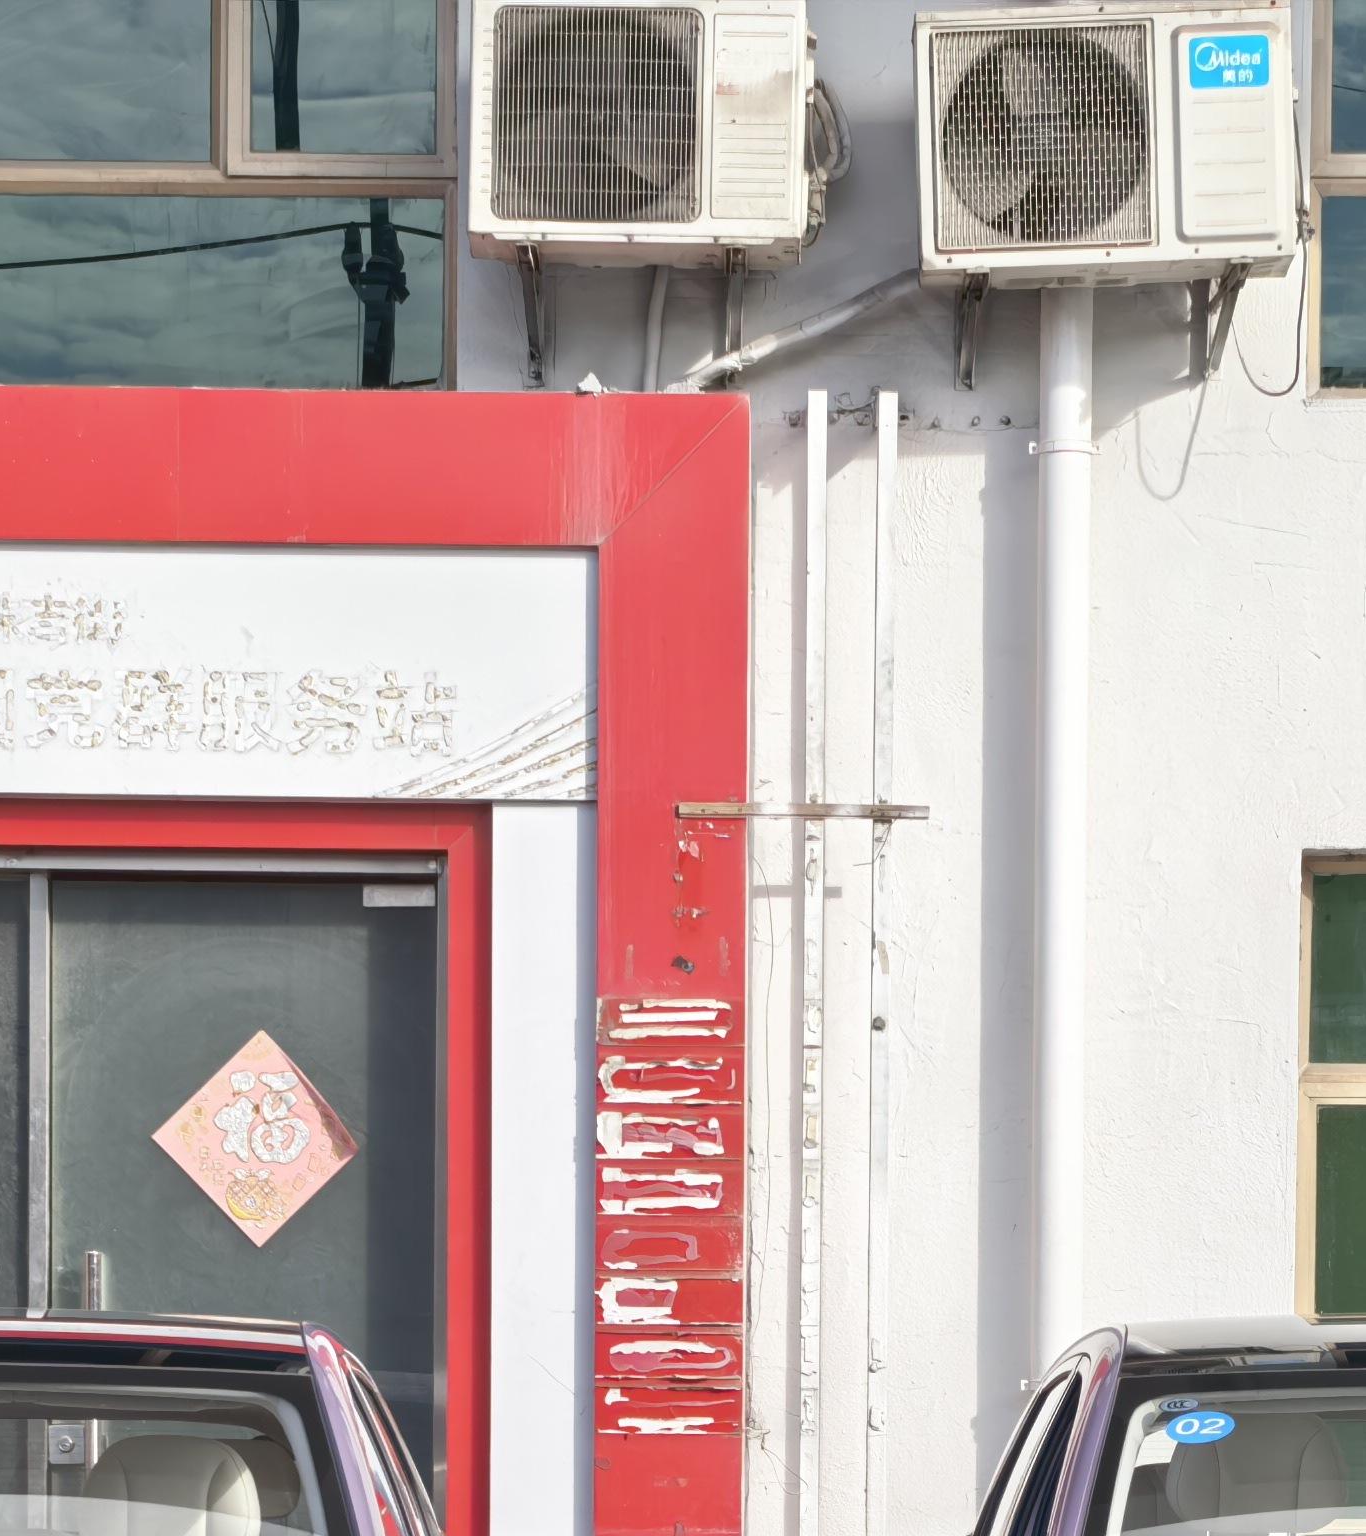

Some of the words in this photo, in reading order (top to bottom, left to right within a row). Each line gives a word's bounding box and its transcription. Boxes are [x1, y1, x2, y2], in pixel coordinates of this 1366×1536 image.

[1204, 47, 1261, 68] Midea
[1222, 69, 1254, 83] 美的
[1176, 1418, 1226, 1435] 02
